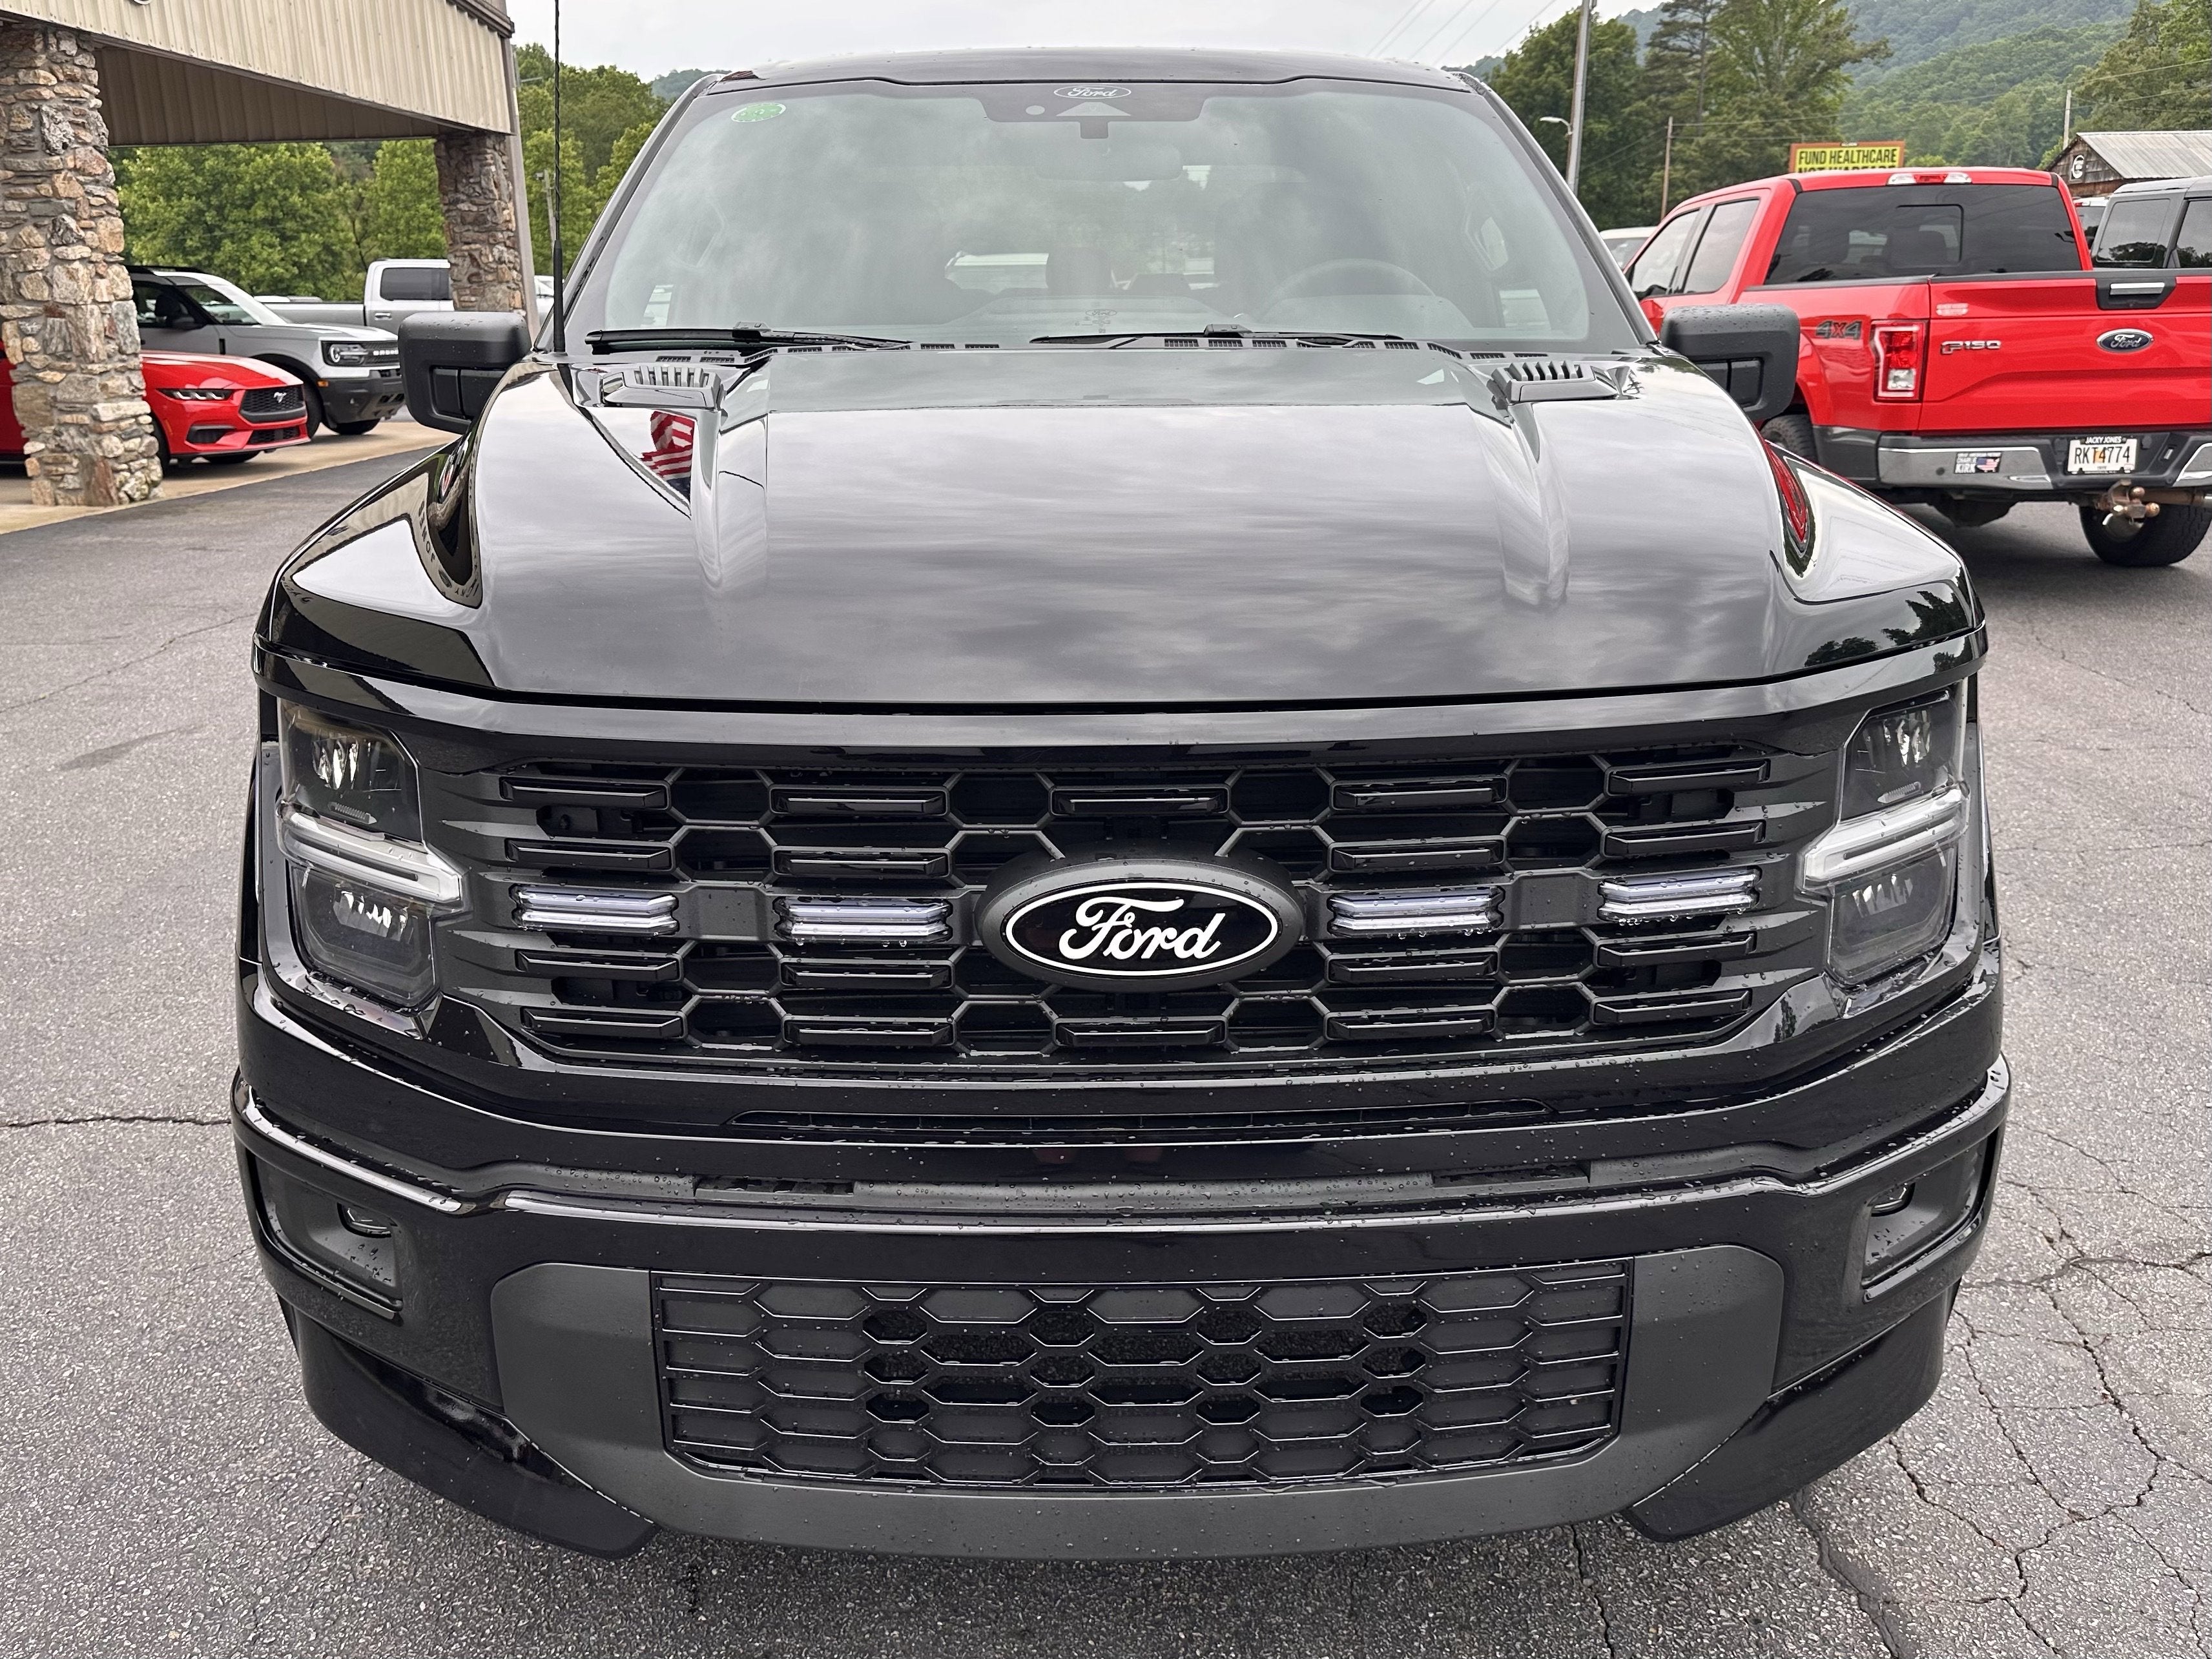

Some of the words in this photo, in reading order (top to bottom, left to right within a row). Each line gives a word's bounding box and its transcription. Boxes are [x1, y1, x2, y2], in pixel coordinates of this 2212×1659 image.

[1068, 87, 1118, 96] Ford
[1798, 150, 1826, 165] FUND
[1830, 149, 1897, 164] HEALTHCARE
[2111, 334, 2142, 347] Ford
[2074, 446, 2130, 464] RKT4774
[1059, 896, 1226, 960] Ford
